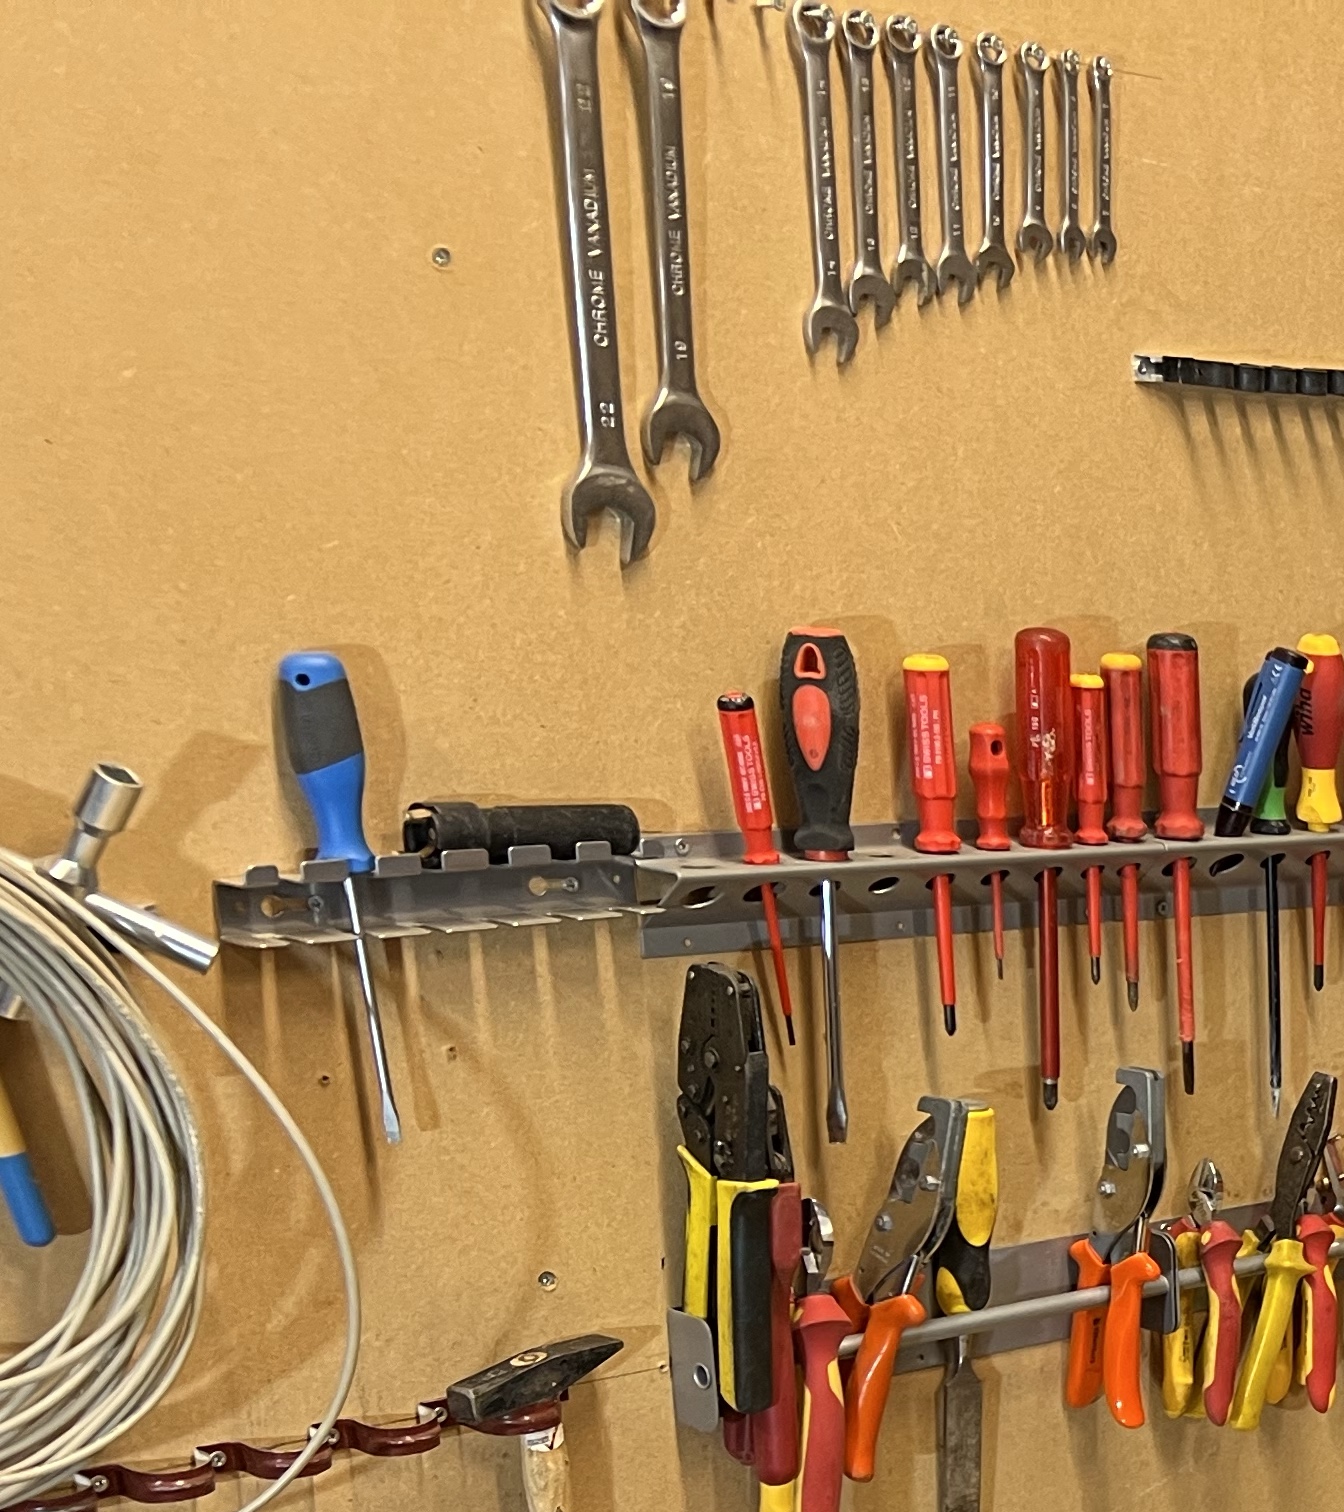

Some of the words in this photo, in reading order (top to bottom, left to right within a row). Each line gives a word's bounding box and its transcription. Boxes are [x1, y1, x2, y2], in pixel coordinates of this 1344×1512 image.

[582, 167, 604, 258] VANADIUM
[665, 145, 681, 222] VANADIUM
[670, 229, 685, 296] CHROME
[588, 268, 608, 348] CHROME
[600, 401, 617, 429] 22
[919, 694, 929, 729] TOOLS
